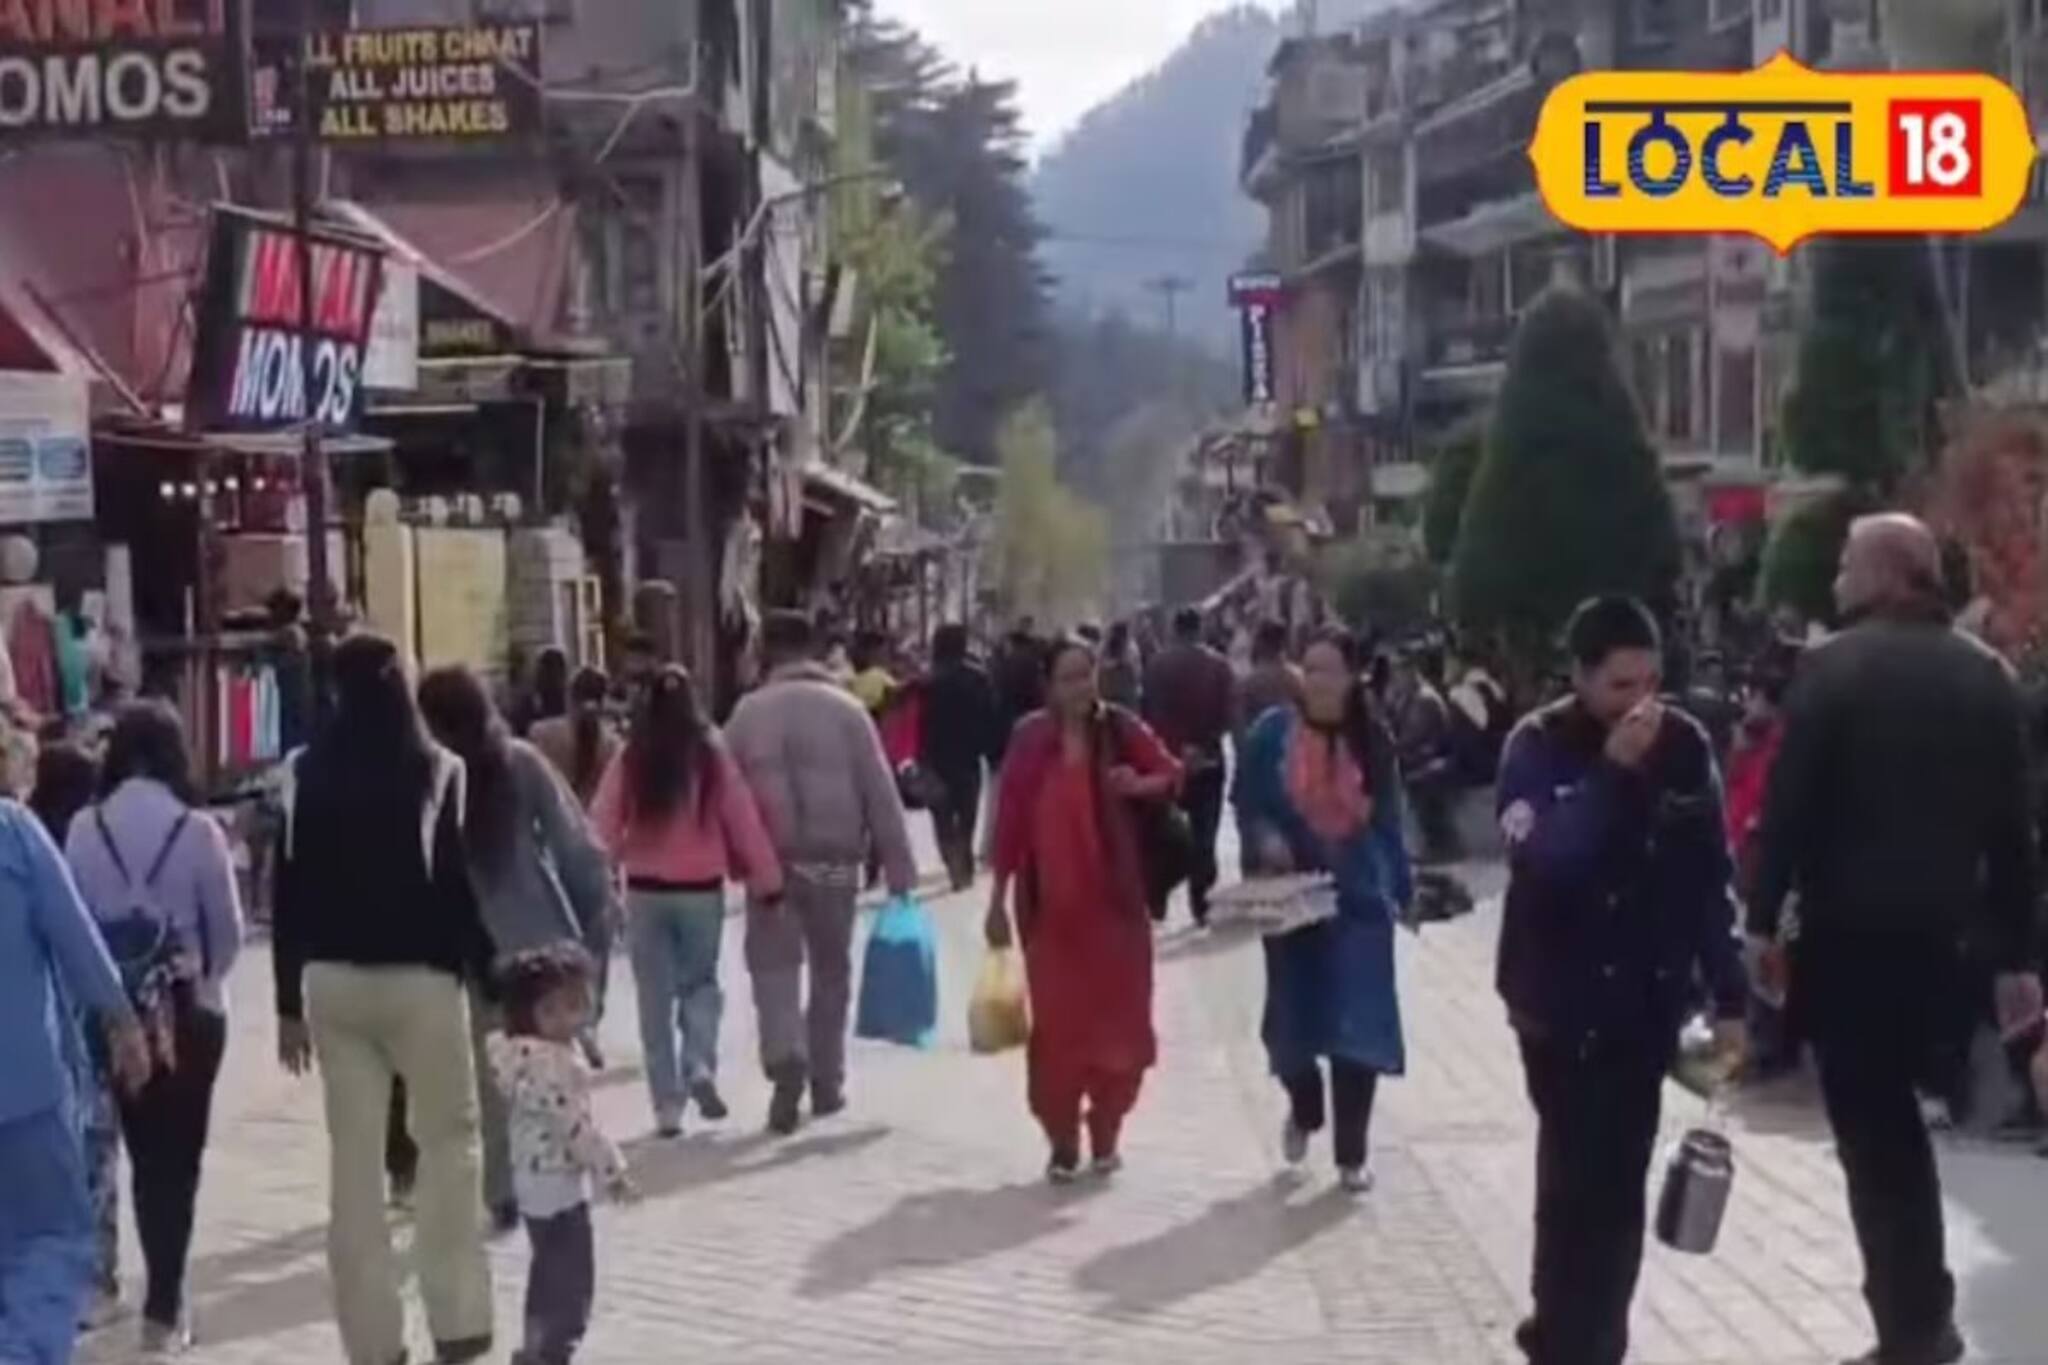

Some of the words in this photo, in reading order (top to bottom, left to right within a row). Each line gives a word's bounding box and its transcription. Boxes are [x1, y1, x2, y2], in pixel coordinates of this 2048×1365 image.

[343, 30, 437, 63] FRUITS
[0, 49, 210, 125] OMOS
[328, 68, 384, 99] ALL
[390, 64, 496, 96] JUICES
[320, 105, 378, 136] ALL
[384, 100, 509, 133] SHAKES
